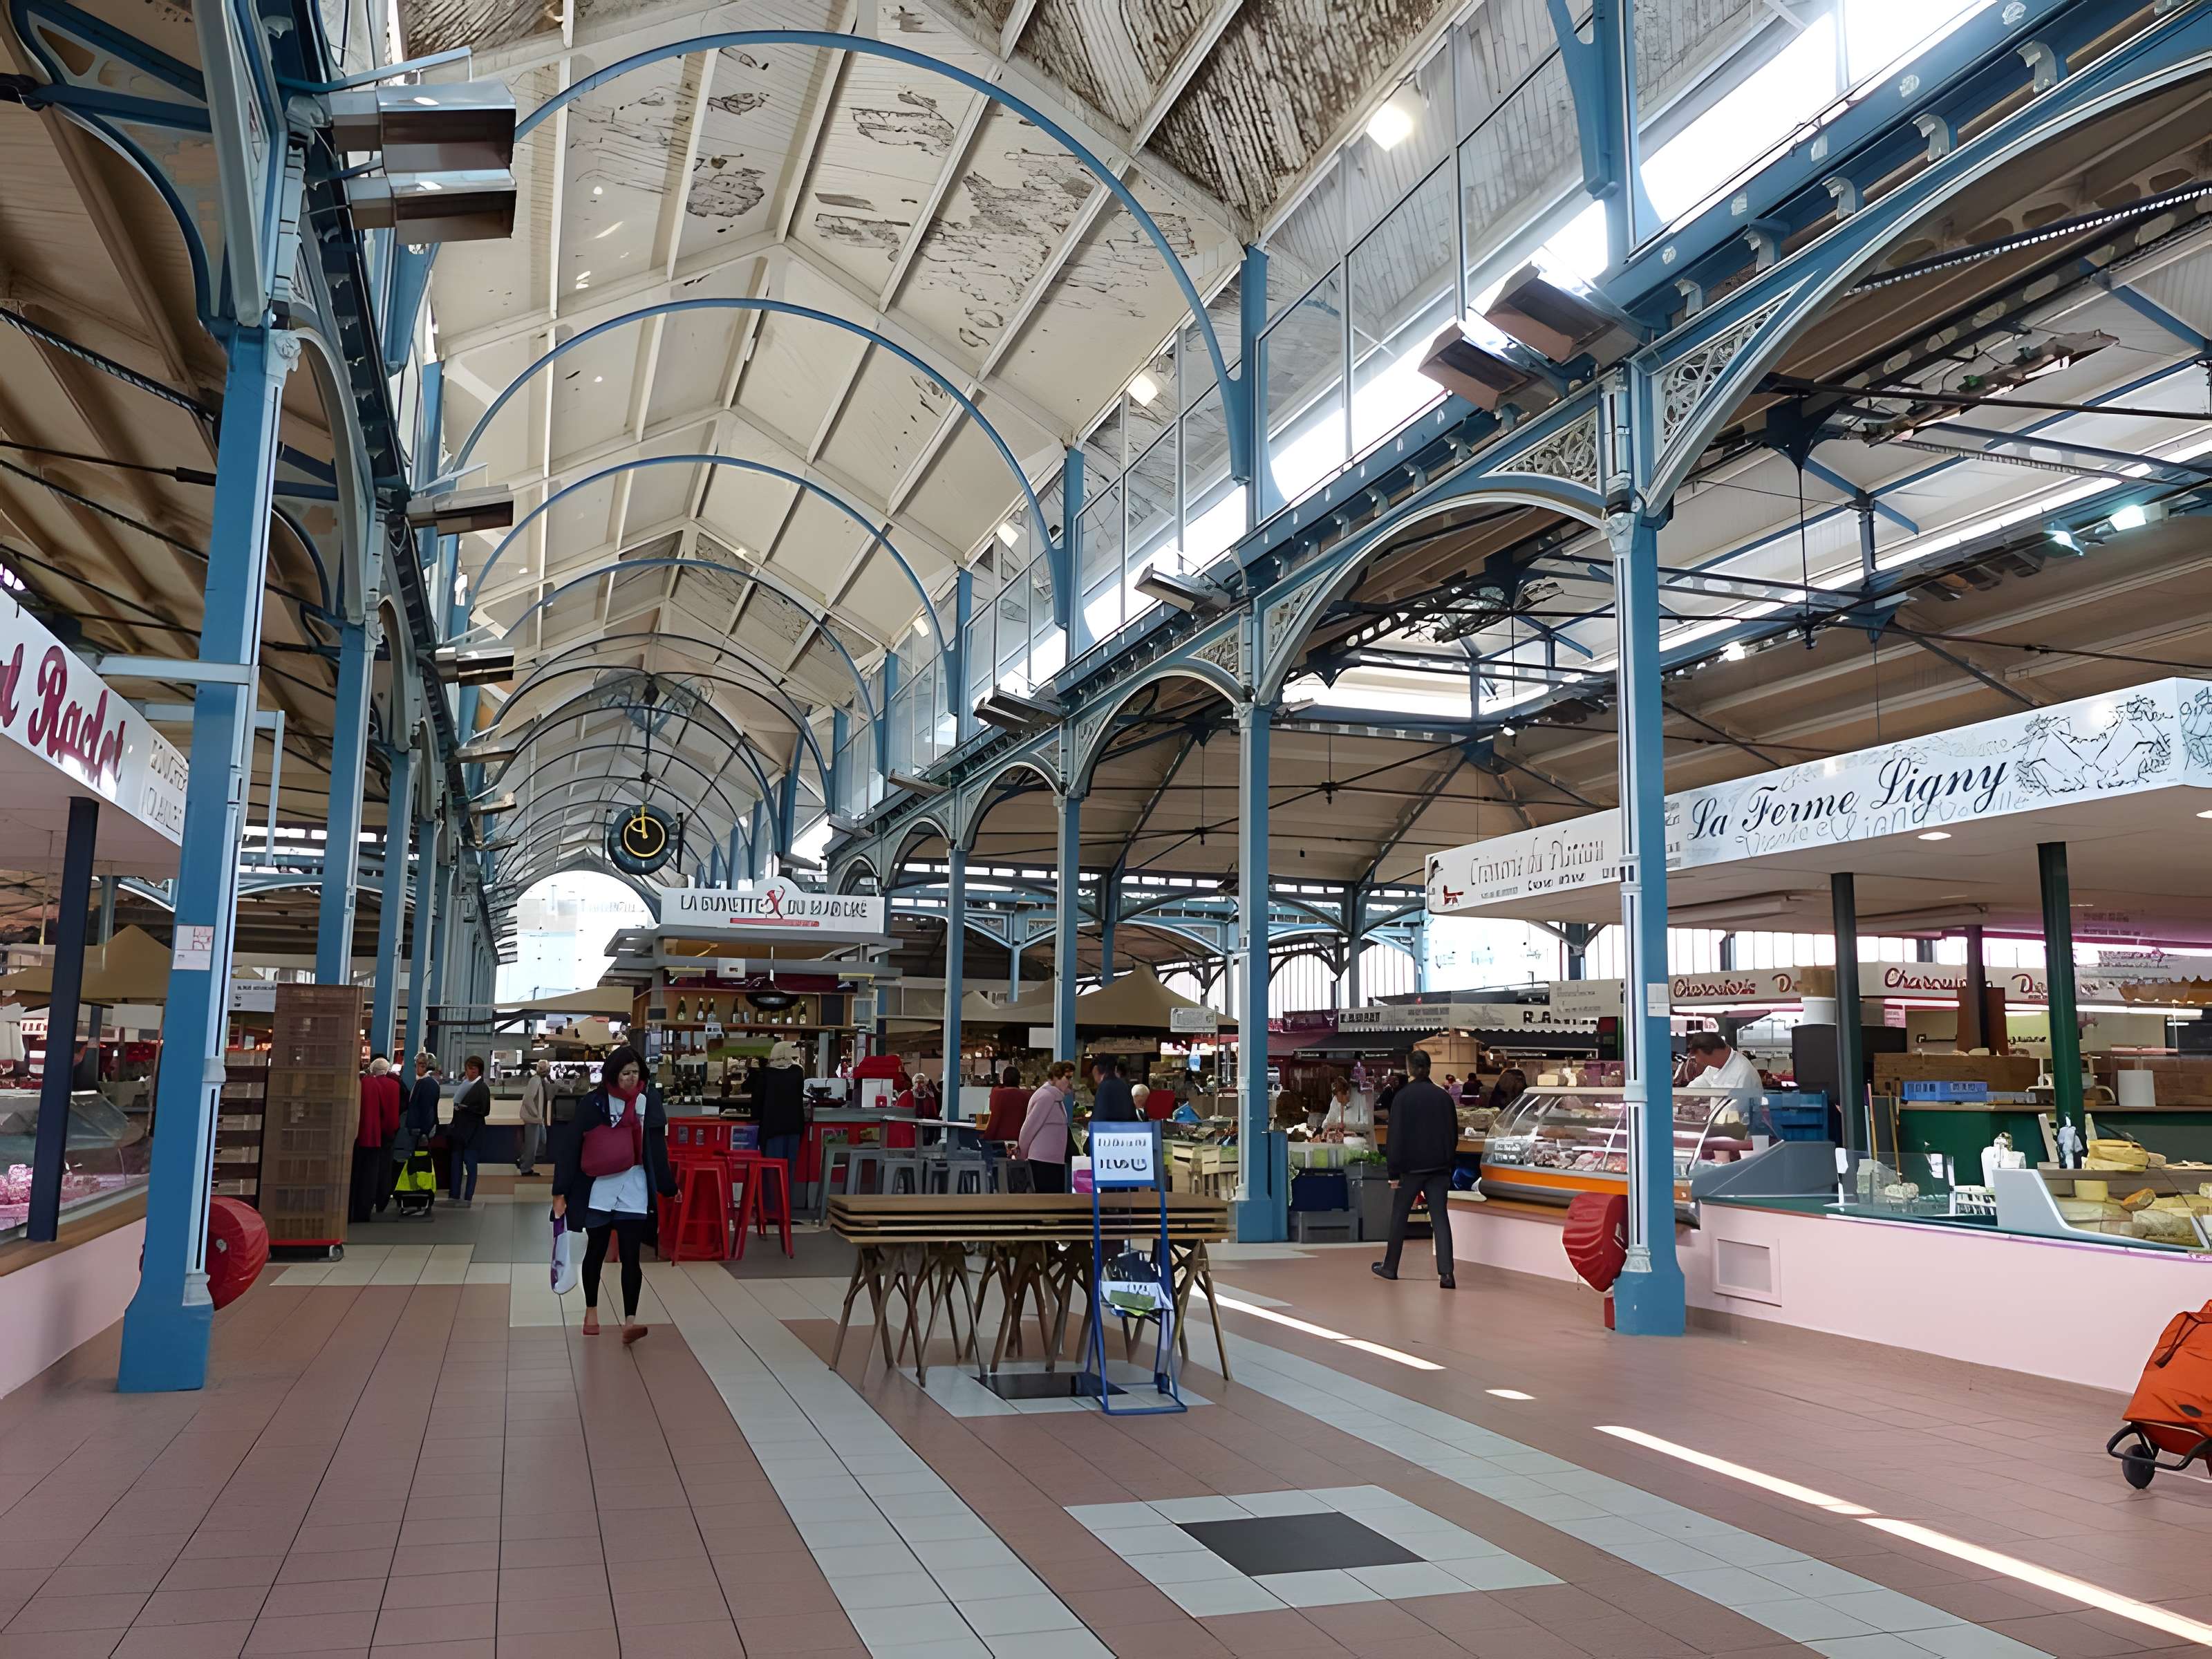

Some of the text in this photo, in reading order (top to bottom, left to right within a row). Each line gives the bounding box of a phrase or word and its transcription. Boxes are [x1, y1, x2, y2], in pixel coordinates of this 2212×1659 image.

[1687, 797, 1728, 841] La
[1741, 786, 1861, 832] Ferme
[1871, 758, 2010, 821] Ligny
